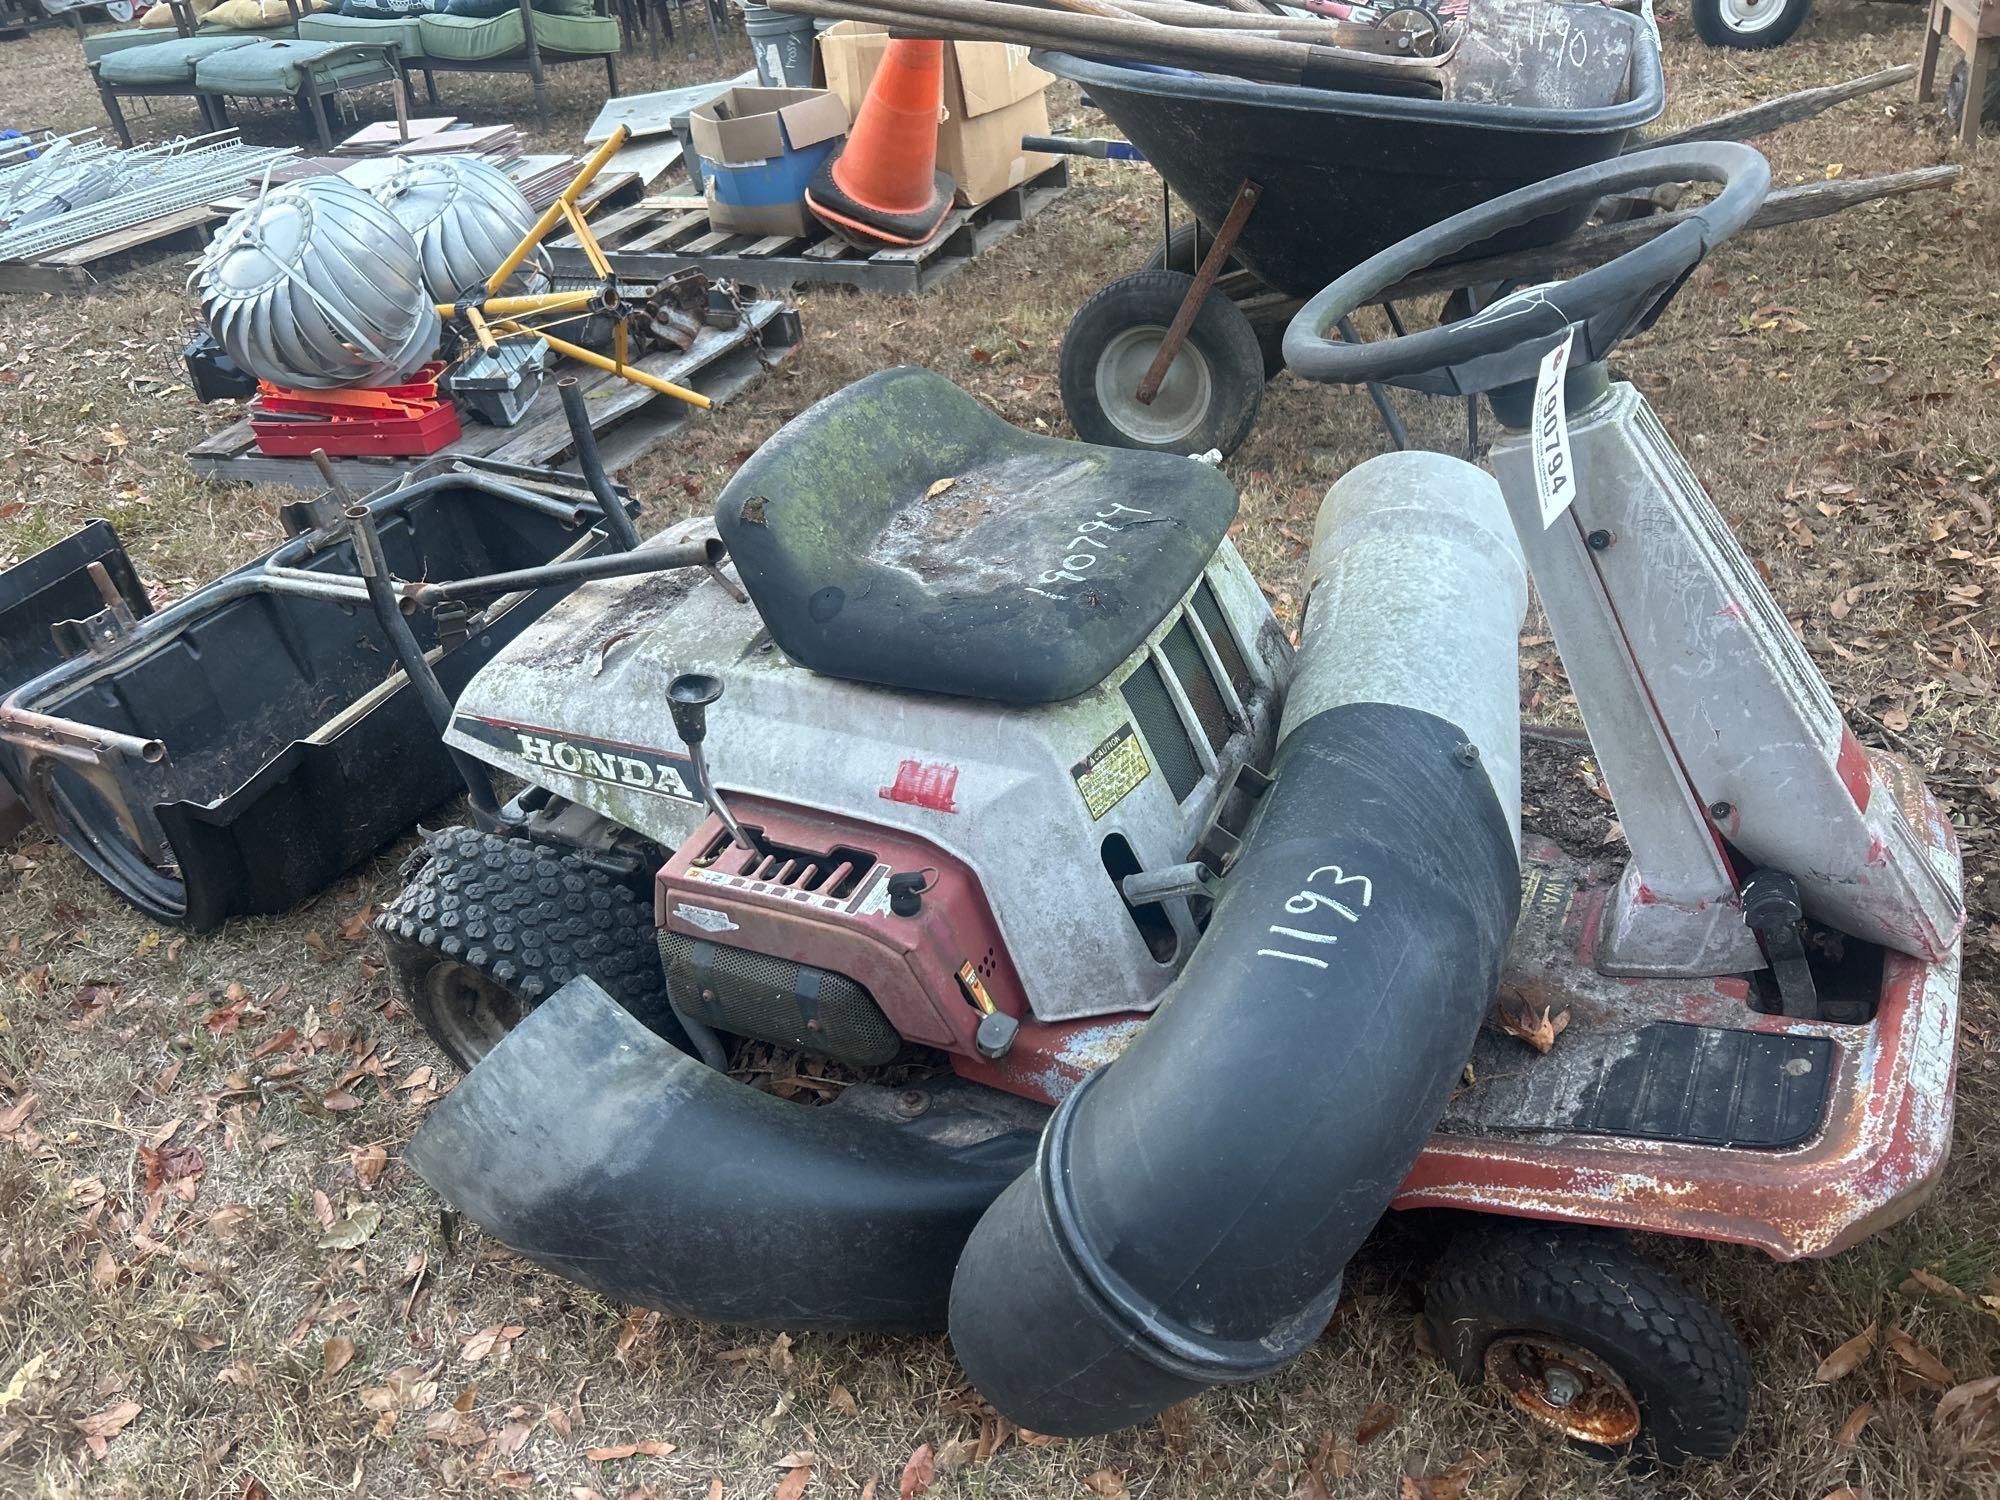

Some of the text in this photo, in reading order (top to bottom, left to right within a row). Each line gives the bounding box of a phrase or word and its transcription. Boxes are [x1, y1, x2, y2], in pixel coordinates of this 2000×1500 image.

[1543, 377, 1567, 496] 190794
[516, 733, 694, 798] HONDA
[1094, 734, 1121, 761] CAUTION
[1257, 865, 1373, 970] 1193
